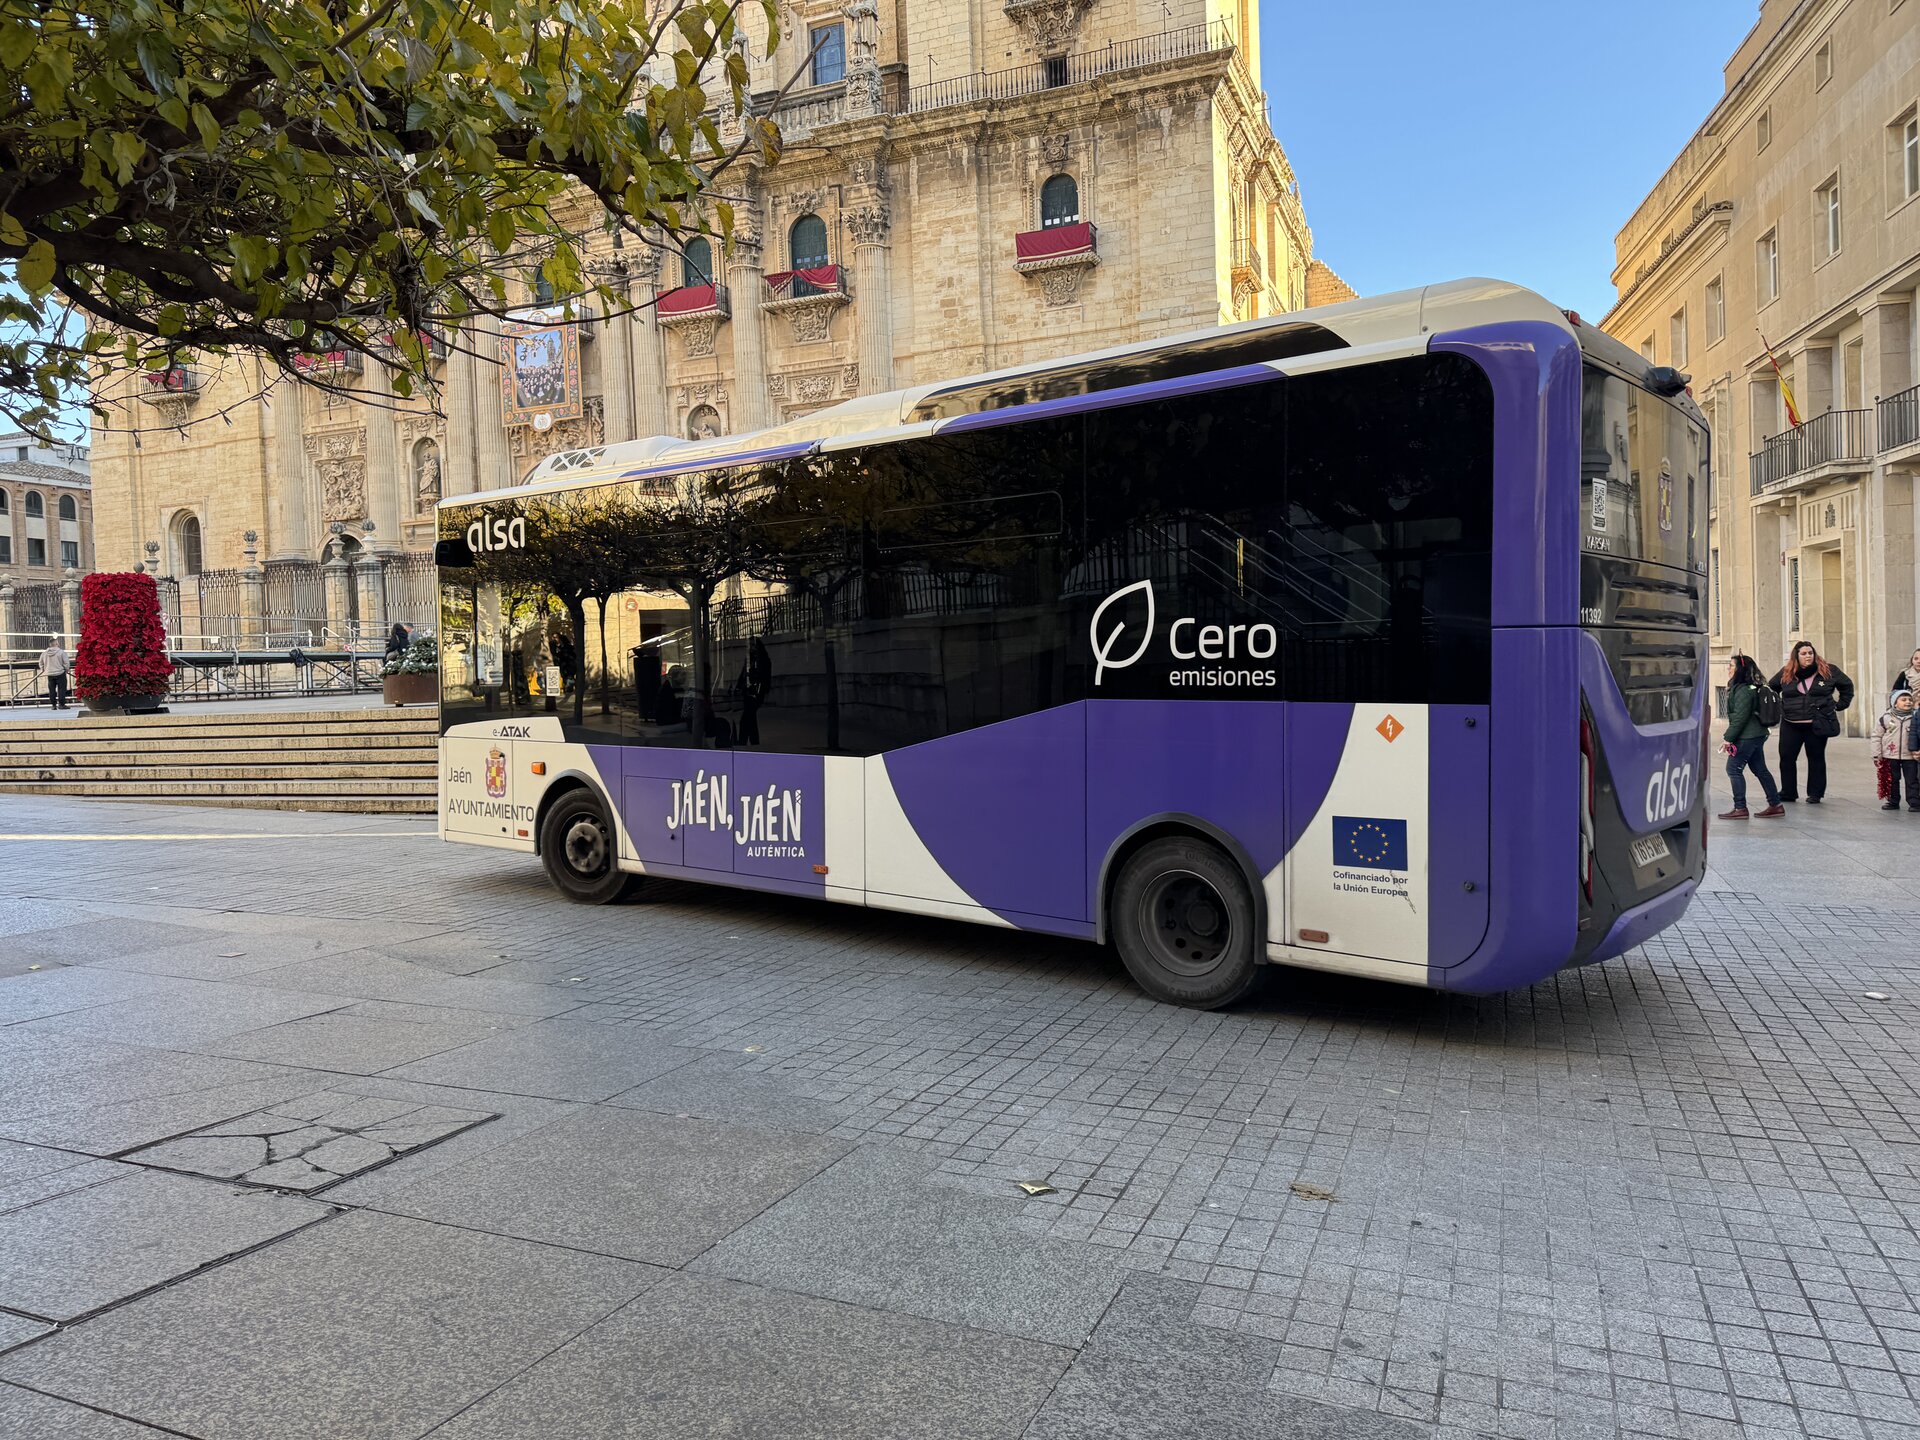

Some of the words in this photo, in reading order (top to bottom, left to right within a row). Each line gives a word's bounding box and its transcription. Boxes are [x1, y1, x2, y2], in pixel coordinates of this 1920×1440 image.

[467, 514, 526, 552] alsa
[1581, 607, 1602, 624] 11392
[1169, 617, 1277, 660] Cero
[1169, 666, 1276, 687] emisiones
[493, 725, 531, 738] e-ATAK
[448, 766, 472, 784] Jaén
[1645, 758, 1691, 824] alsa
[448, 798, 535, 822] AYUNTAMIENTO
[735, 784, 802, 845] JAÉN
[747, 844, 805, 858] AUTÉNTICA
[1333, 871, 1391, 883] Cofinanciado
[1392, 876, 1409, 885] por
[1333, 882, 1341, 891] la
[1343, 883, 1369, 893] Unión
[1371, 886, 1409, 897] Europea
